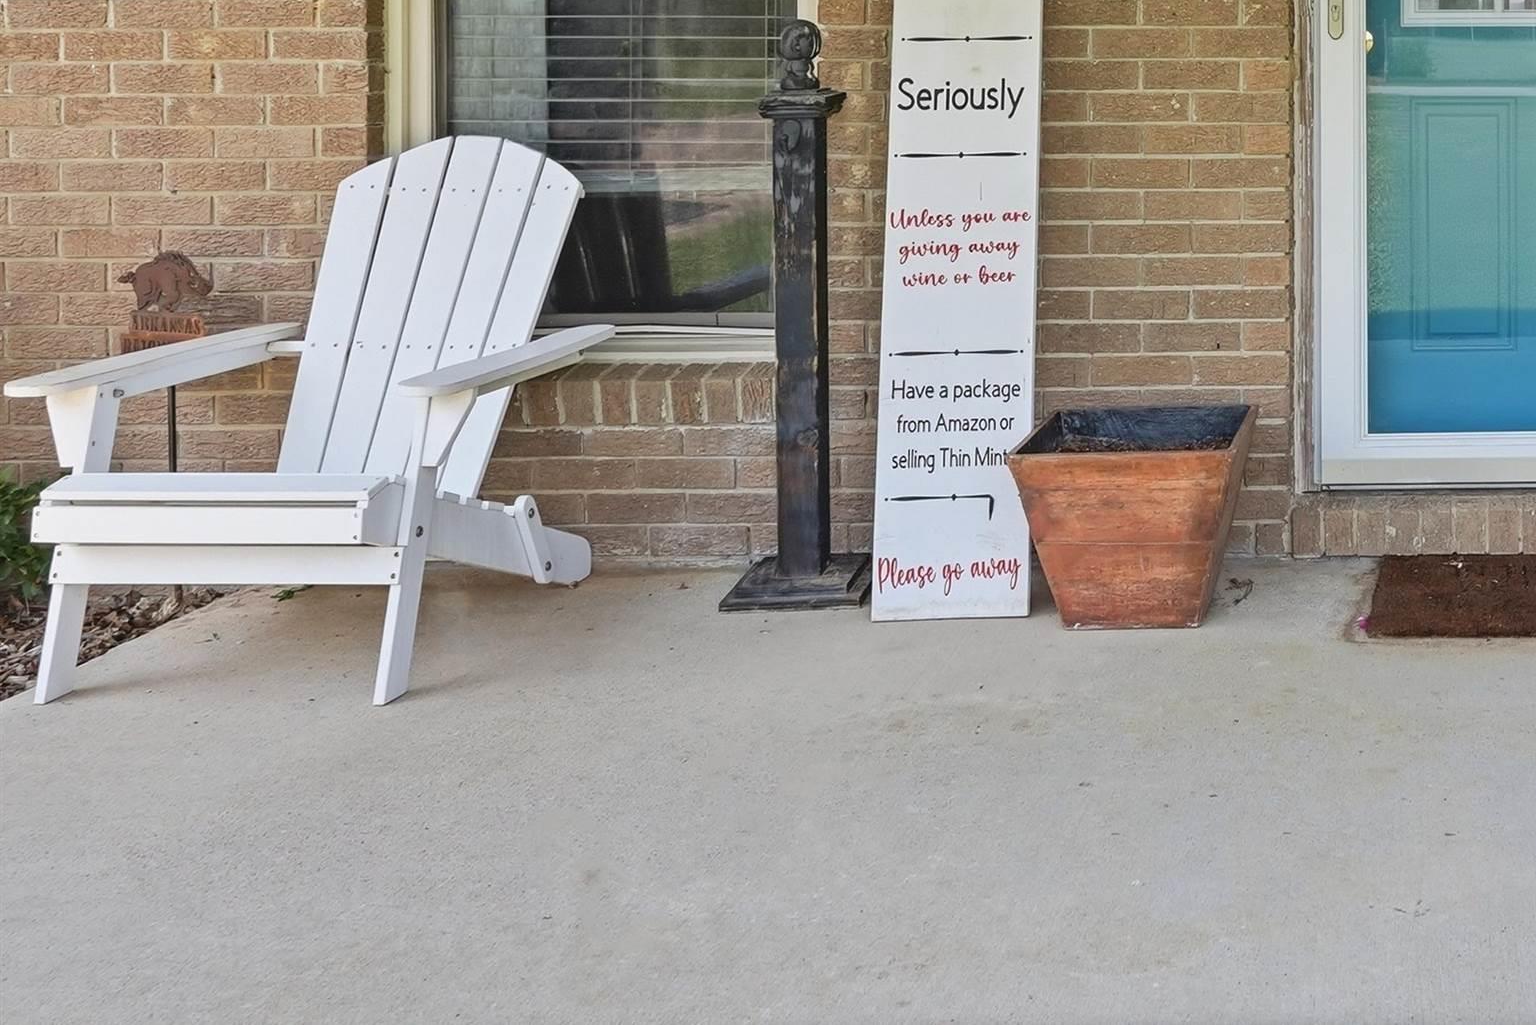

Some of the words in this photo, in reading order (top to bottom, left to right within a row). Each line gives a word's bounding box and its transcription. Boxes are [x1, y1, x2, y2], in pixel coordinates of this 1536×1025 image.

[897, 78, 1024, 118] Seriously
[890, 208, 954, 229] Unless
[962, 212, 997, 232] you
[1002, 210, 1031, 222] are
[899, 240, 962, 264] giving
[969, 242, 1020, 259] away
[902, 272, 948, 287] wine
[954, 274, 972, 284] or
[978, 265, 1016, 284] beer
[131, 314, 203, 334] ARKANSAS
[891, 379, 934, 399] Have
[940, 384, 948, 398] a
[953, 379, 1021, 403] package
[897, 415, 931, 432] from
[934, 414, 996, 432] Amazon
[1000, 416, 1015, 430] or
[892, 449, 935, 473] selling
[940, 447, 971, 468] Thin
[975, 446, 1009, 467] Mint
[877, 557, 935, 594] Please
[941, 566, 964, 596] go
[970, 557, 1022, 590] away
